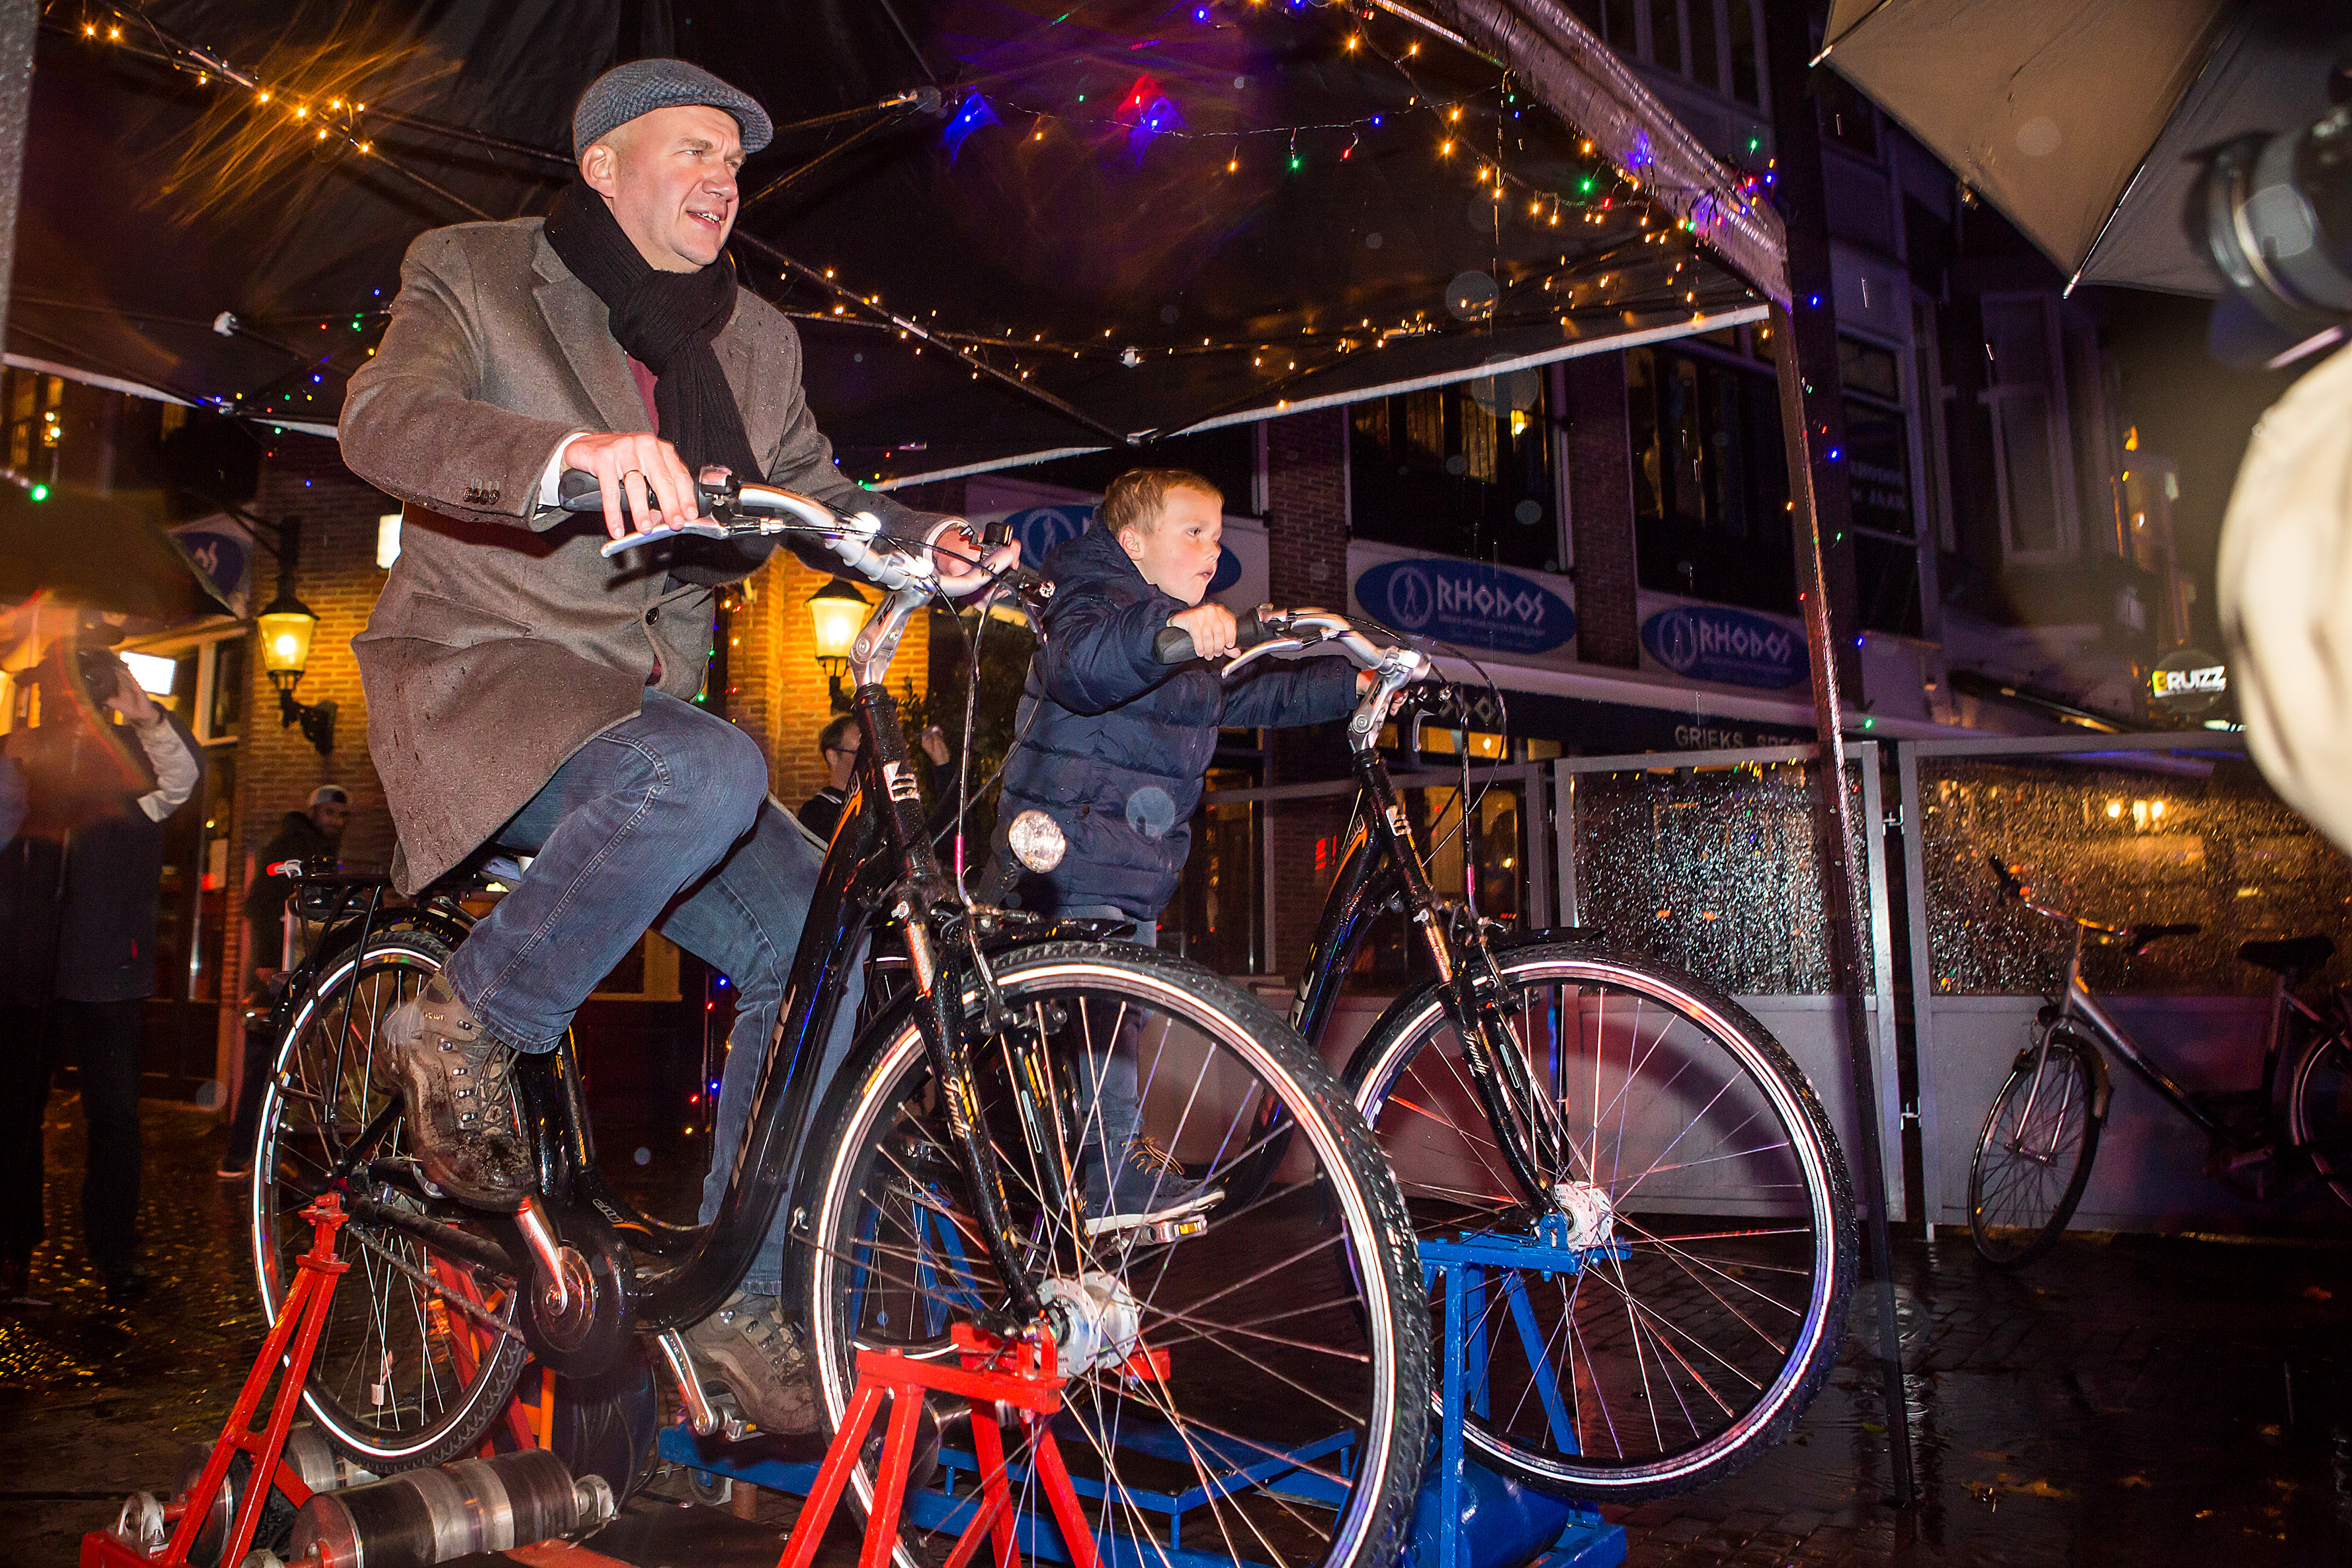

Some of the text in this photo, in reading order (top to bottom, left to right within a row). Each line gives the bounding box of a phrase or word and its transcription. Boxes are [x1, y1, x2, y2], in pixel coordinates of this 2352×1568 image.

[1437, 574, 1545, 626] RHODOS
[1699, 618, 1792, 665] RHODOS
[1675, 724, 1745, 750] GRIEKS
[1462, 1031, 1489, 1077] Trendy
[942, 1076, 971, 1139] Trendy
